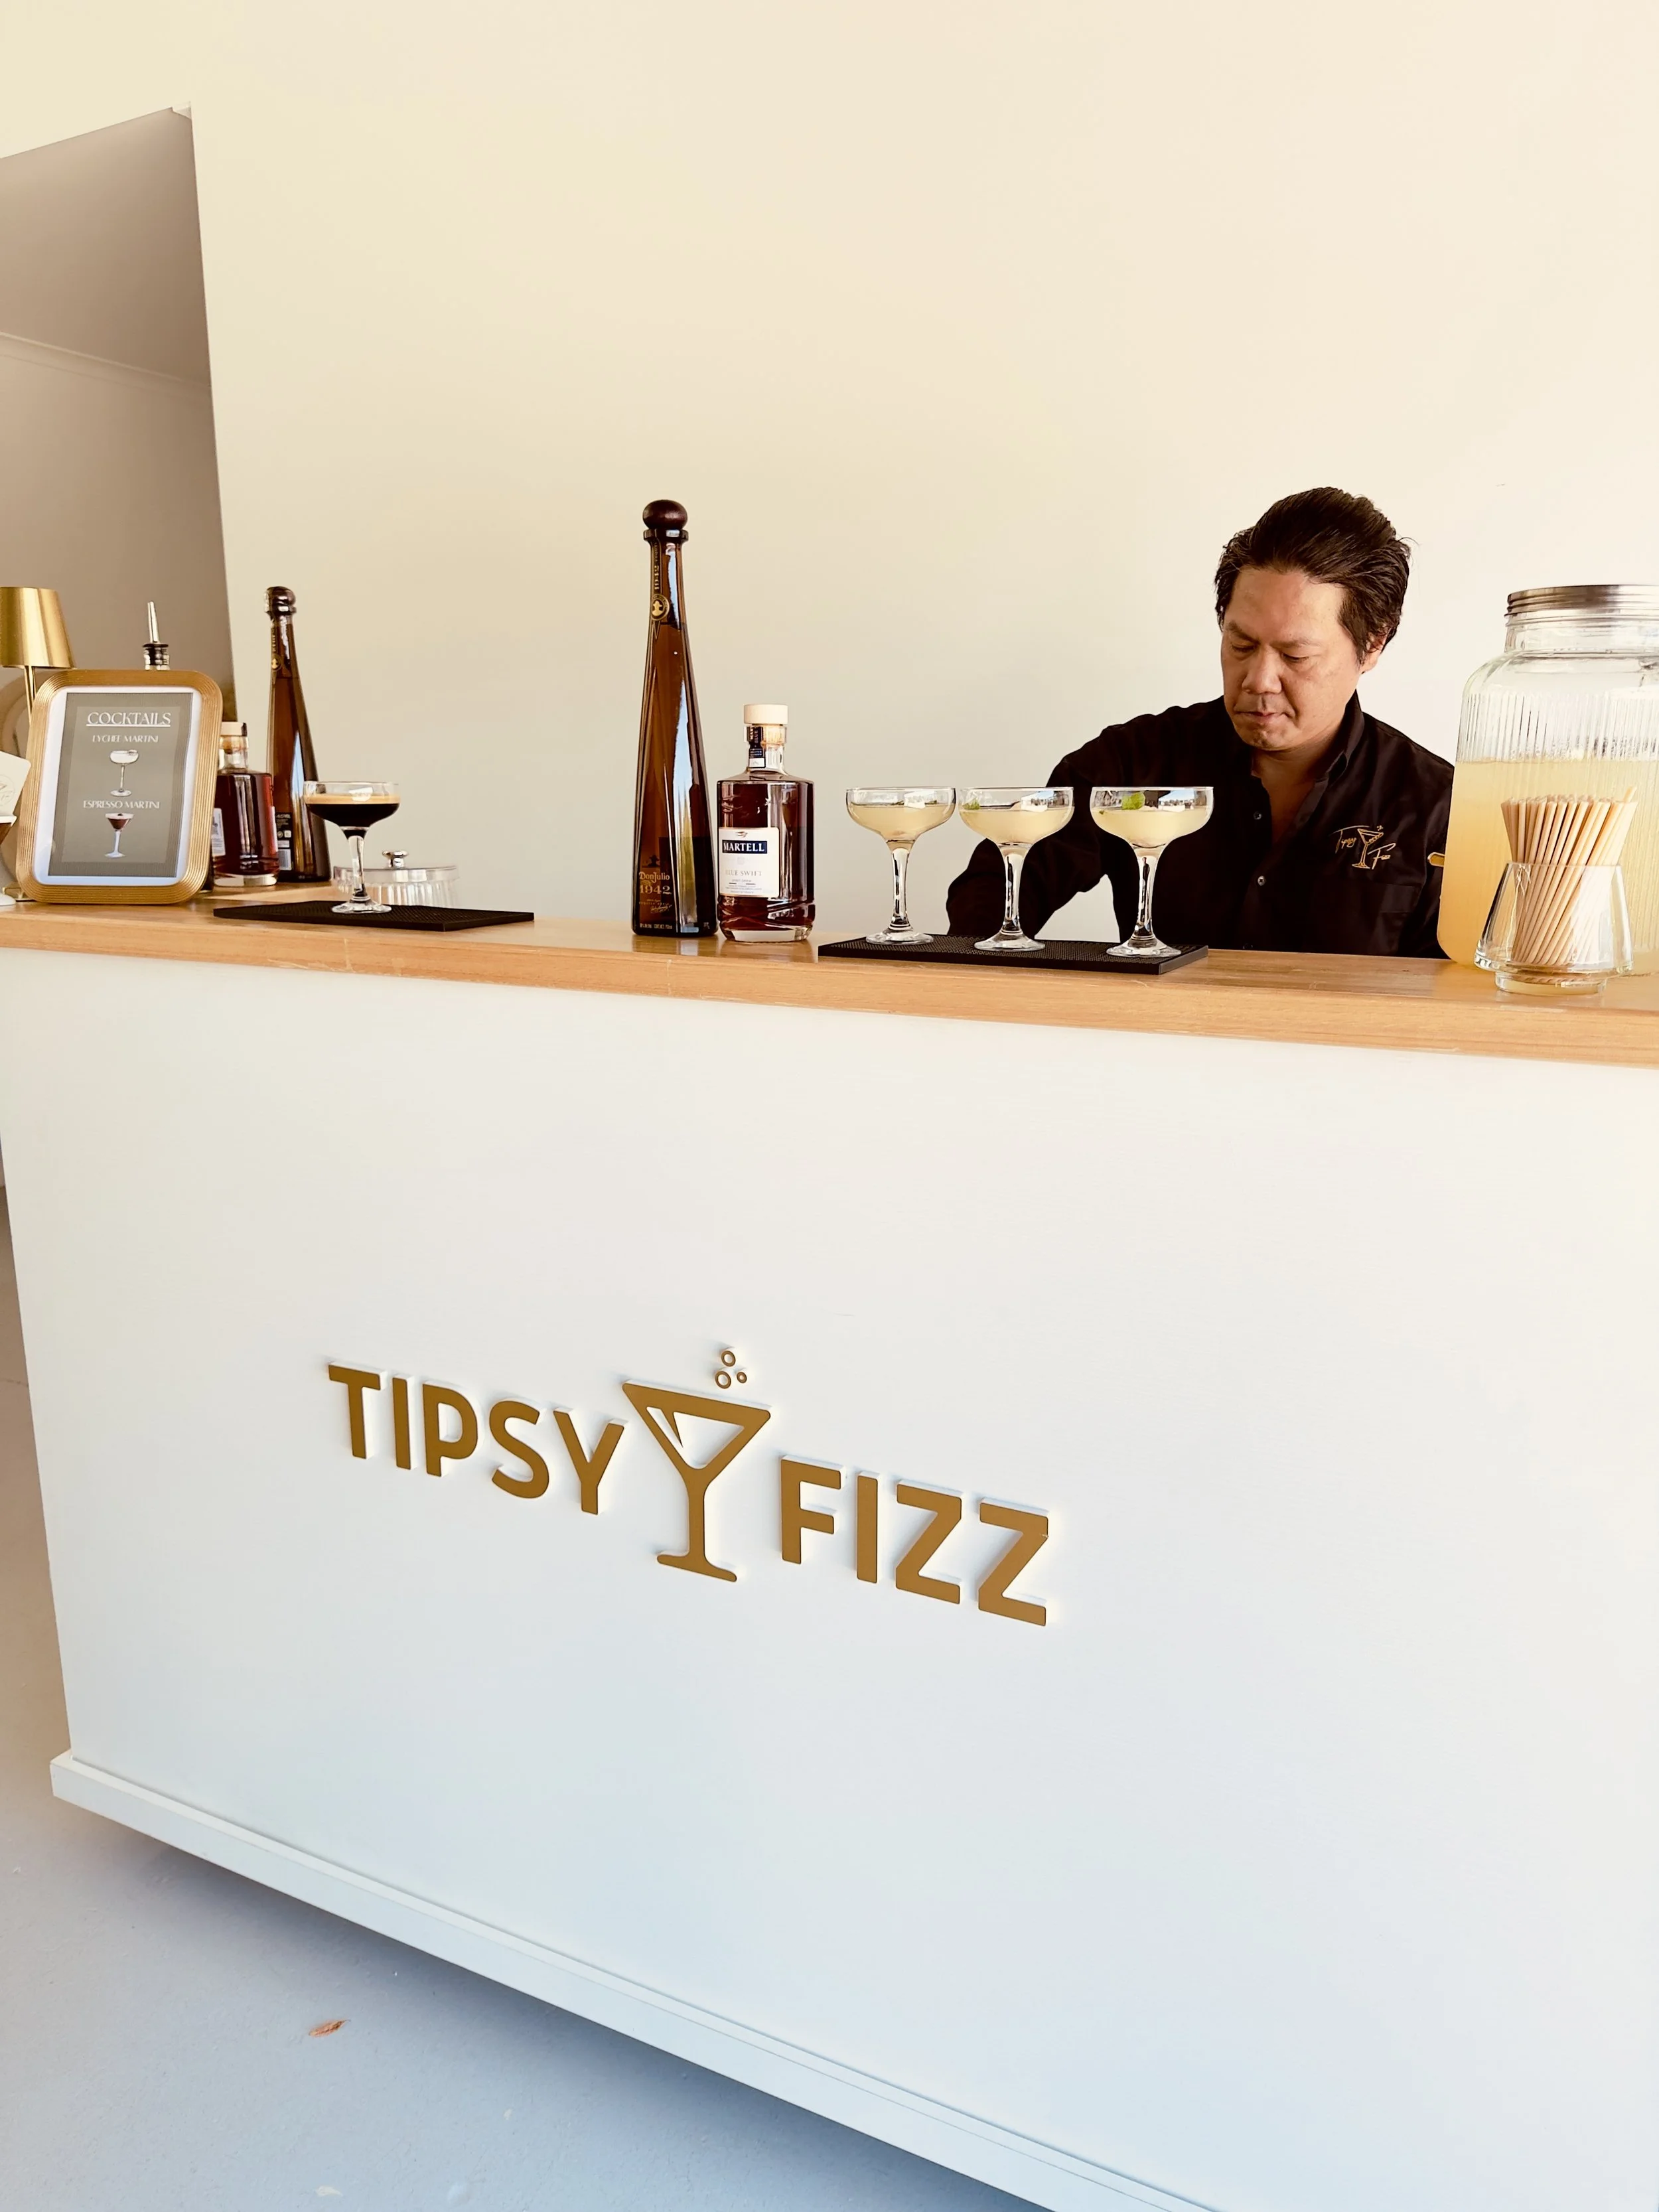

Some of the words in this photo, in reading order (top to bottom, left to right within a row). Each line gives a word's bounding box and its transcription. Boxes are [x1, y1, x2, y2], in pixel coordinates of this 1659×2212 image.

[87, 711, 171, 726] COCKTAILS
[92, 735, 121, 743] LYCHEE
[124, 735, 159, 743] MARTINI
[83, 800, 123, 809] ESPRESSO
[124, 800, 160, 809] MARTINI
[723, 842, 764, 852] MARTELL
[640, 885, 672, 895] 1942
[327, 1364, 625, 1516] TIPSY
[780, 1455, 1050, 1627] FIZZ
